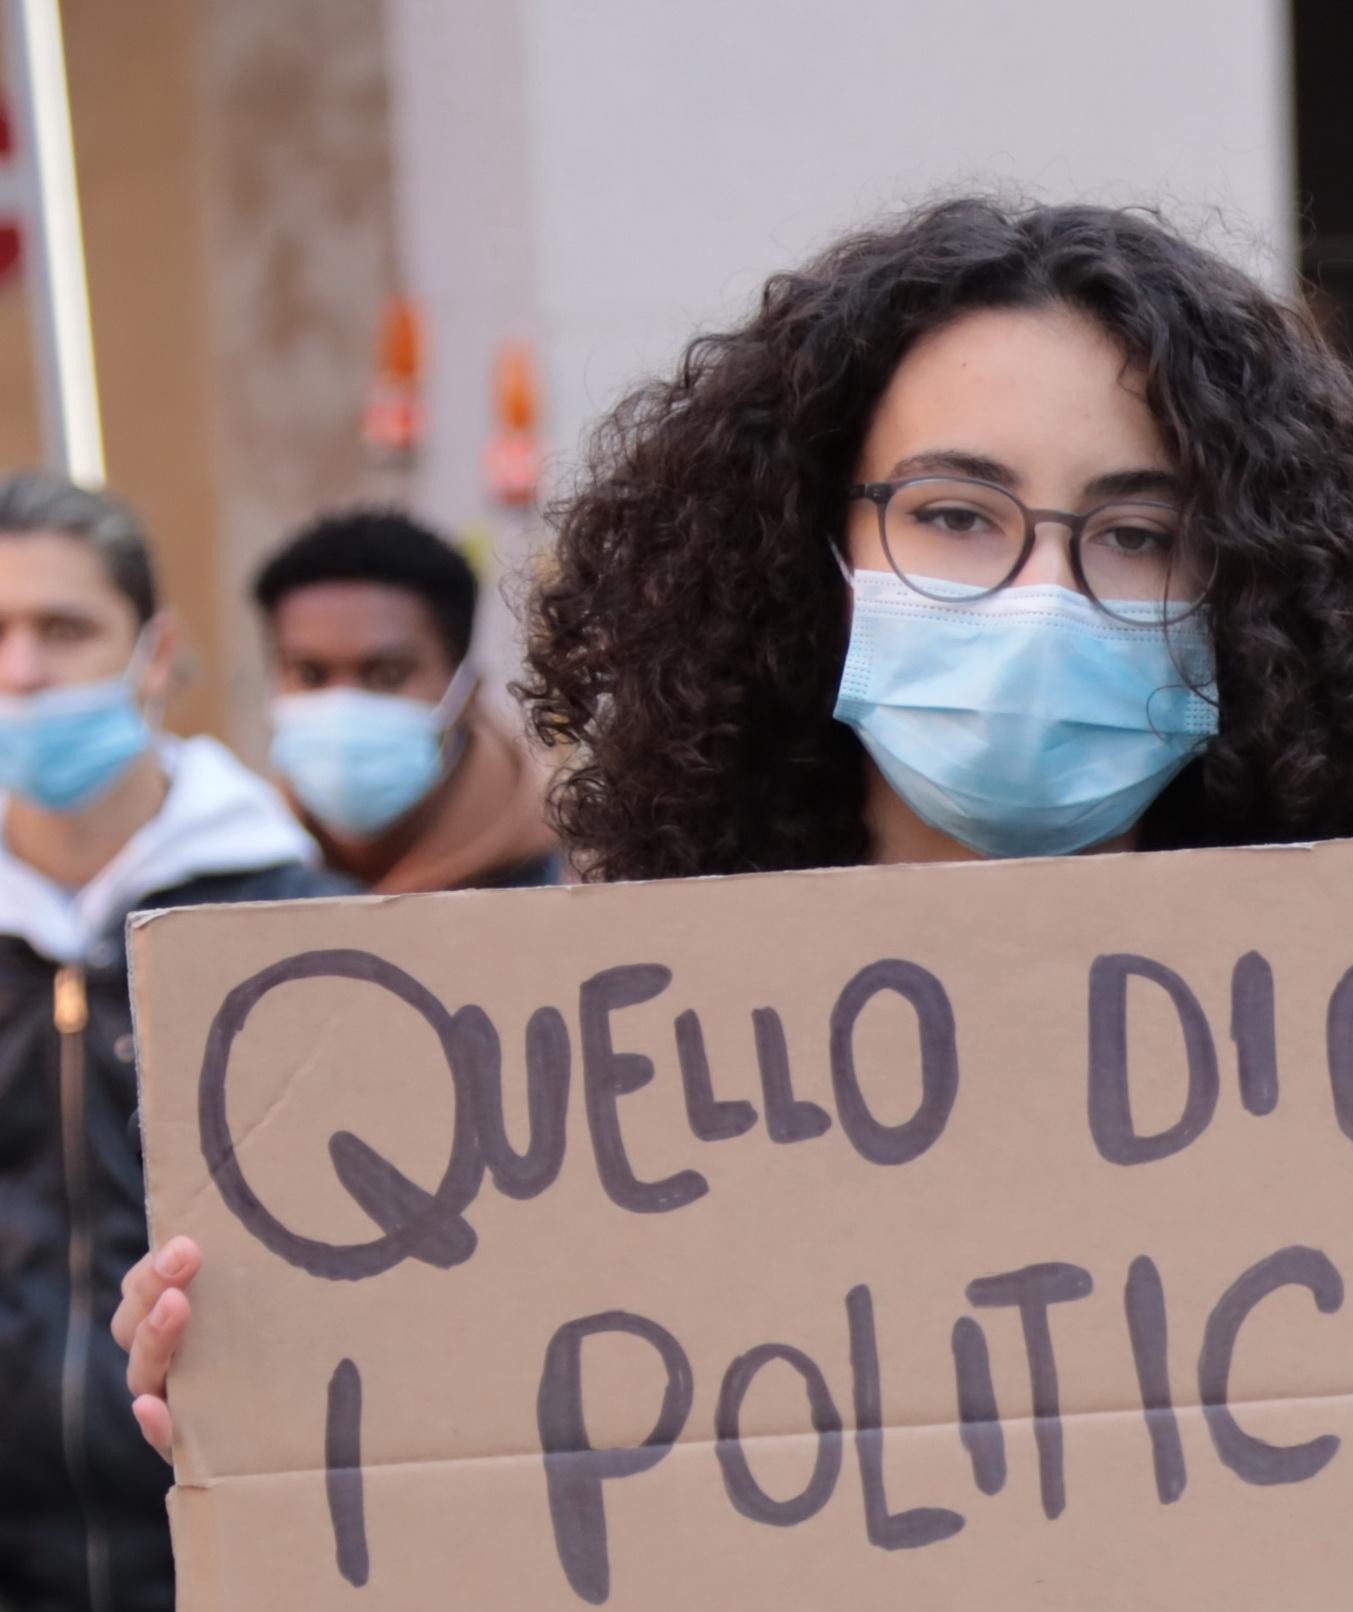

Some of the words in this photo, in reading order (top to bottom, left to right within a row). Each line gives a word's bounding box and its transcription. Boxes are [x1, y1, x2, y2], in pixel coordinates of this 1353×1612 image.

[198, 949, 959, 1281] QUELLO
[1088, 950, 1279, 1167] DI
[325, 1358, 370, 1588] I
